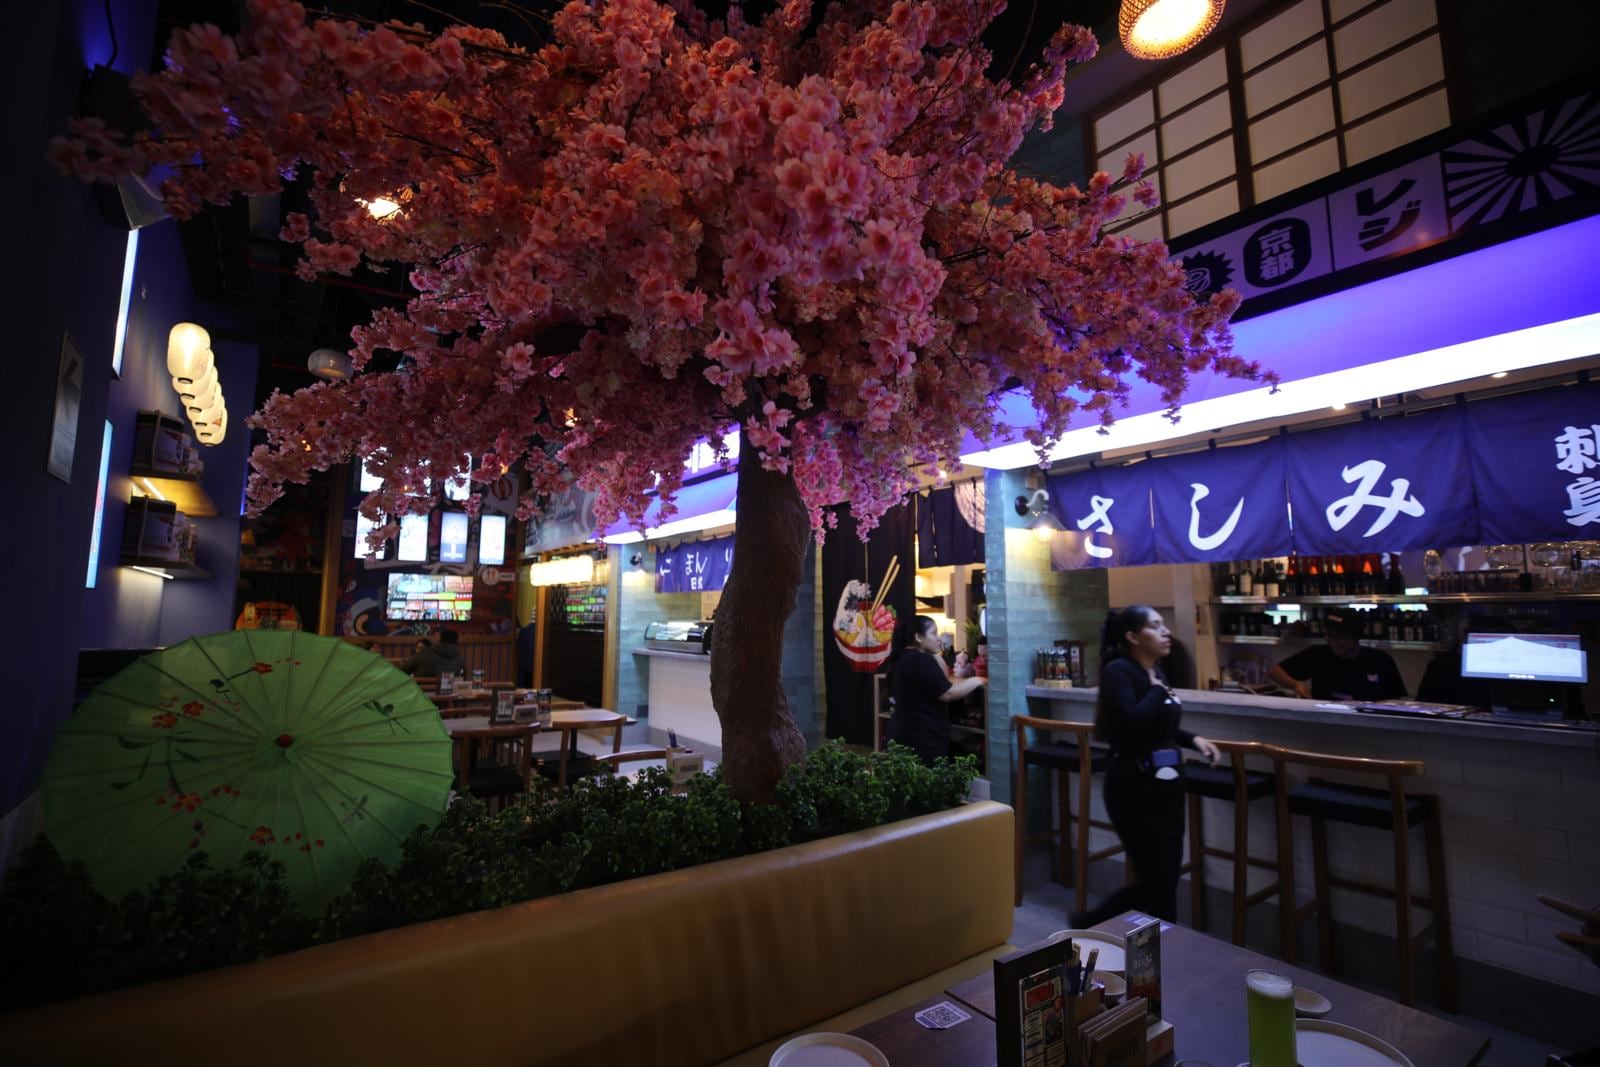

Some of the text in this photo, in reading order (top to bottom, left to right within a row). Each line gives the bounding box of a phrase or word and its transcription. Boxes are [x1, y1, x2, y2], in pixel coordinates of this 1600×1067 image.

[1356, 179, 1421, 251] レジ
[1258, 226, 1294, 281] 京都
[1077, 459, 1425, 559] さしみ
